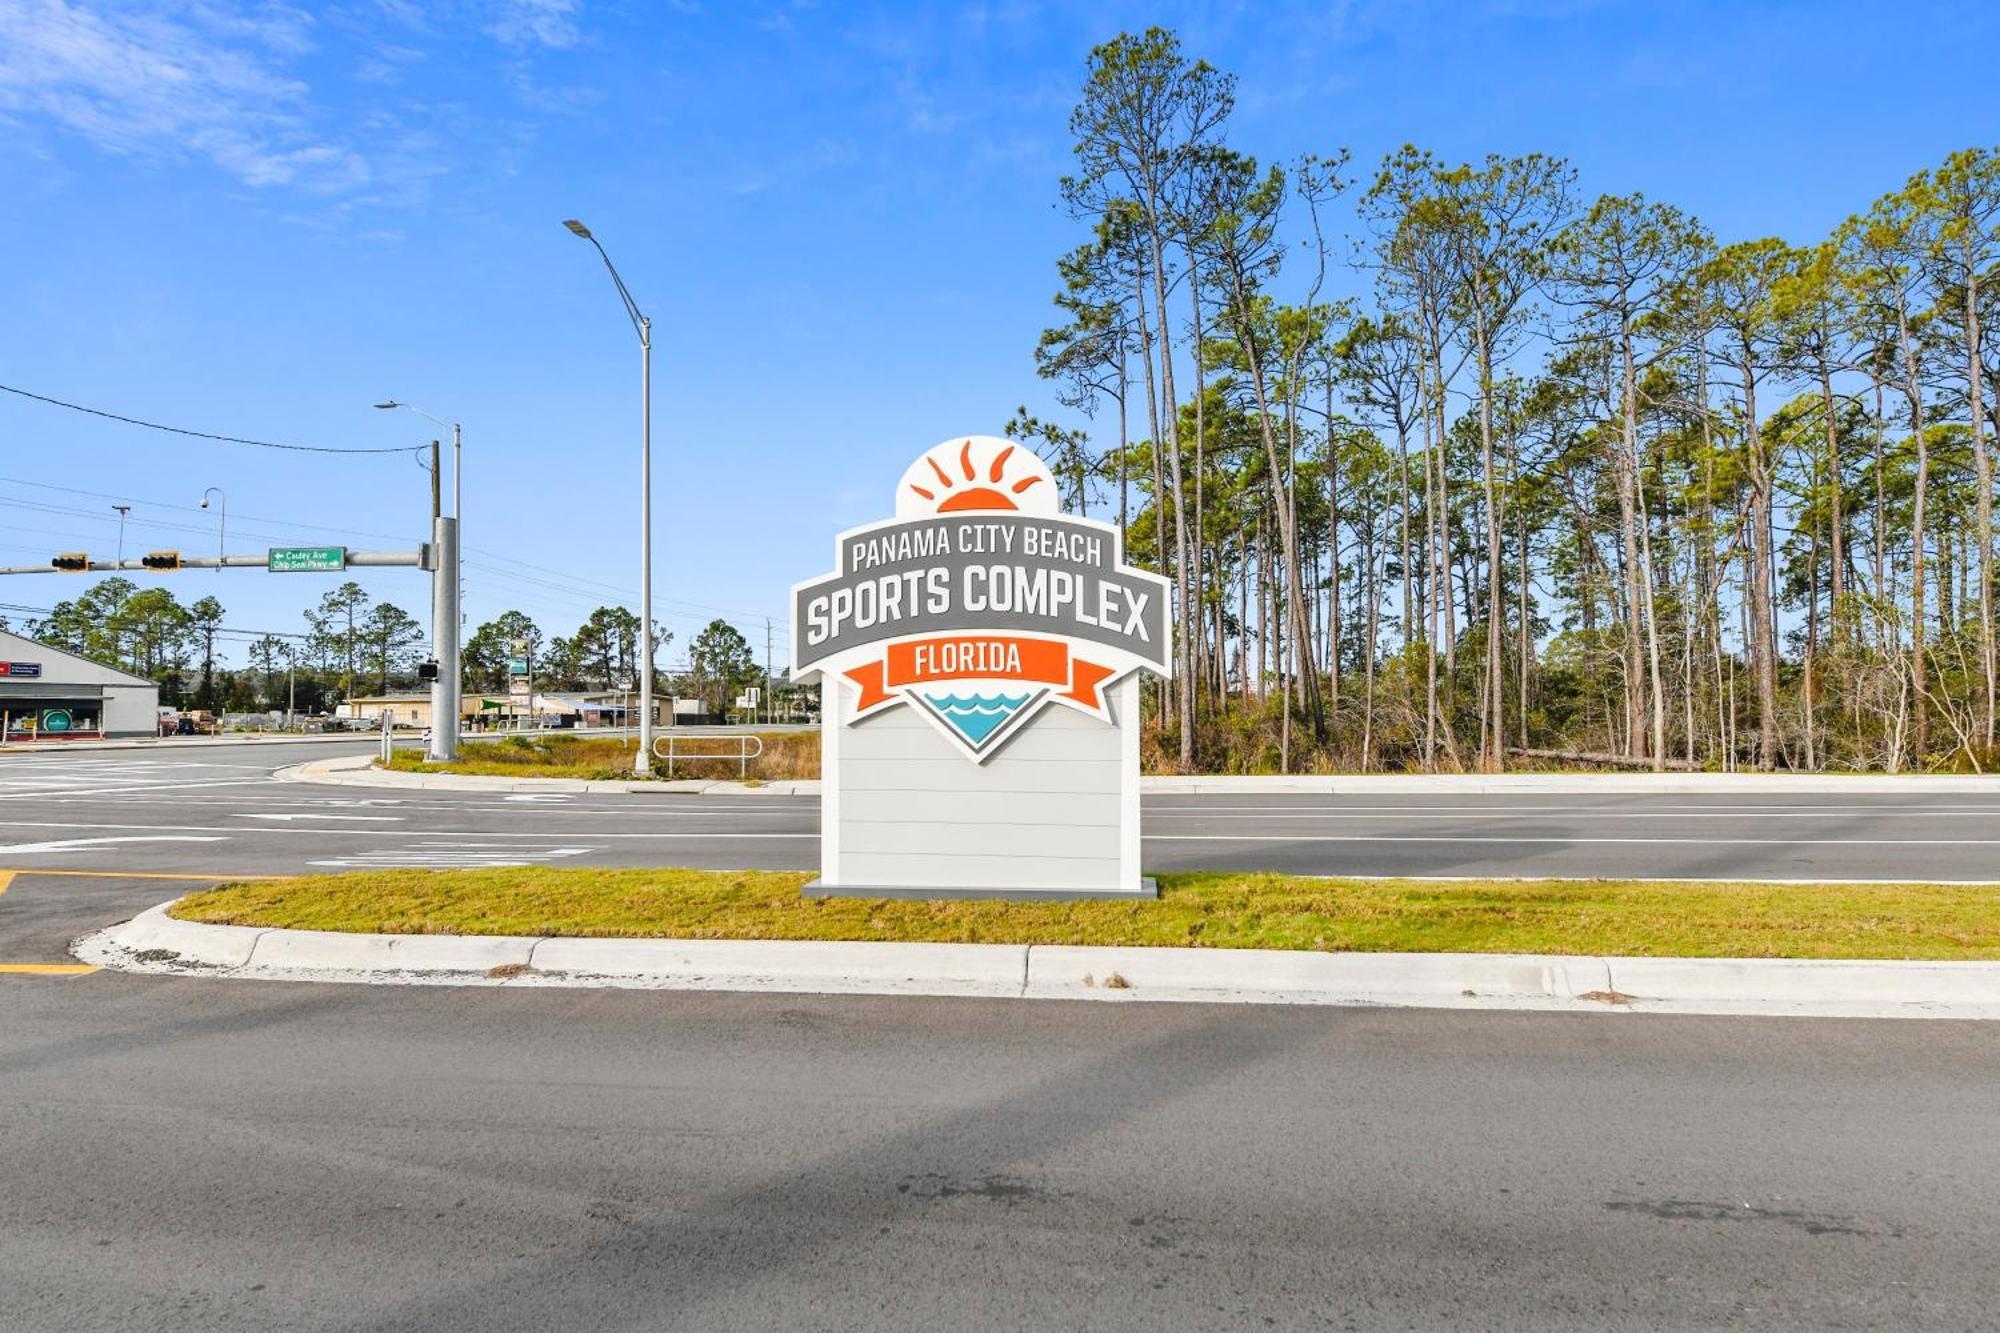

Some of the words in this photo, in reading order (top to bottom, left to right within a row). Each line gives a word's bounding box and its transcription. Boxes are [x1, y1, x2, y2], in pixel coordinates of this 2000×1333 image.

[273, 560, 290, 570] Chip
[312, 551, 328, 560] Ave
[852, 526, 950, 572] PANAMA
[958, 524, 1015, 553] CITY
[1023, 526, 1101, 568] BEACH
[806, 567, 950, 646] SPORTS
[963, 564, 1151, 643] COMPLEX
[914, 641, 1022, 676] FLORIDA
